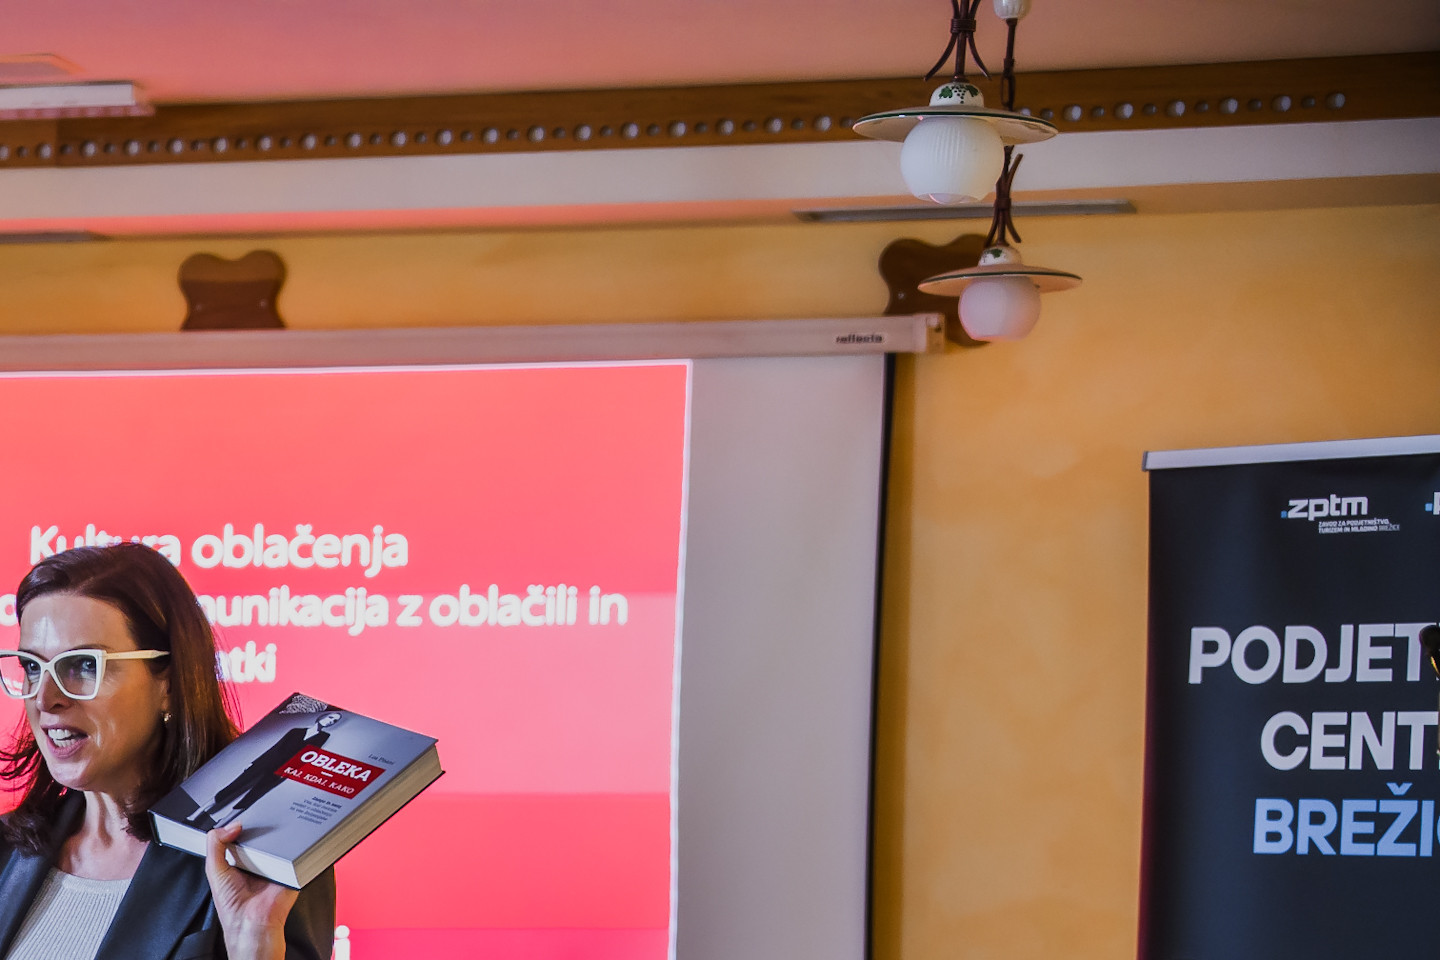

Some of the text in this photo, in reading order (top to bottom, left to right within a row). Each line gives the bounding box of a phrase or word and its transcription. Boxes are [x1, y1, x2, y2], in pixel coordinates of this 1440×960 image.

[191, 523, 409, 578] oblačenja
[195, 584, 390, 636] unikacija
[396, 593, 424, 627] z
[429, 583, 578, 627] oblačili
[588, 584, 629, 626] in
[215, 640, 277, 684] tki
[1189, 622, 1440, 684] PODJET
[300, 750, 372, 782] OBLEKA
[1261, 711, 1440, 770] CENT
[328, 781, 355, 795] KAKO
[1253, 782, 1440, 856] BREŽI
